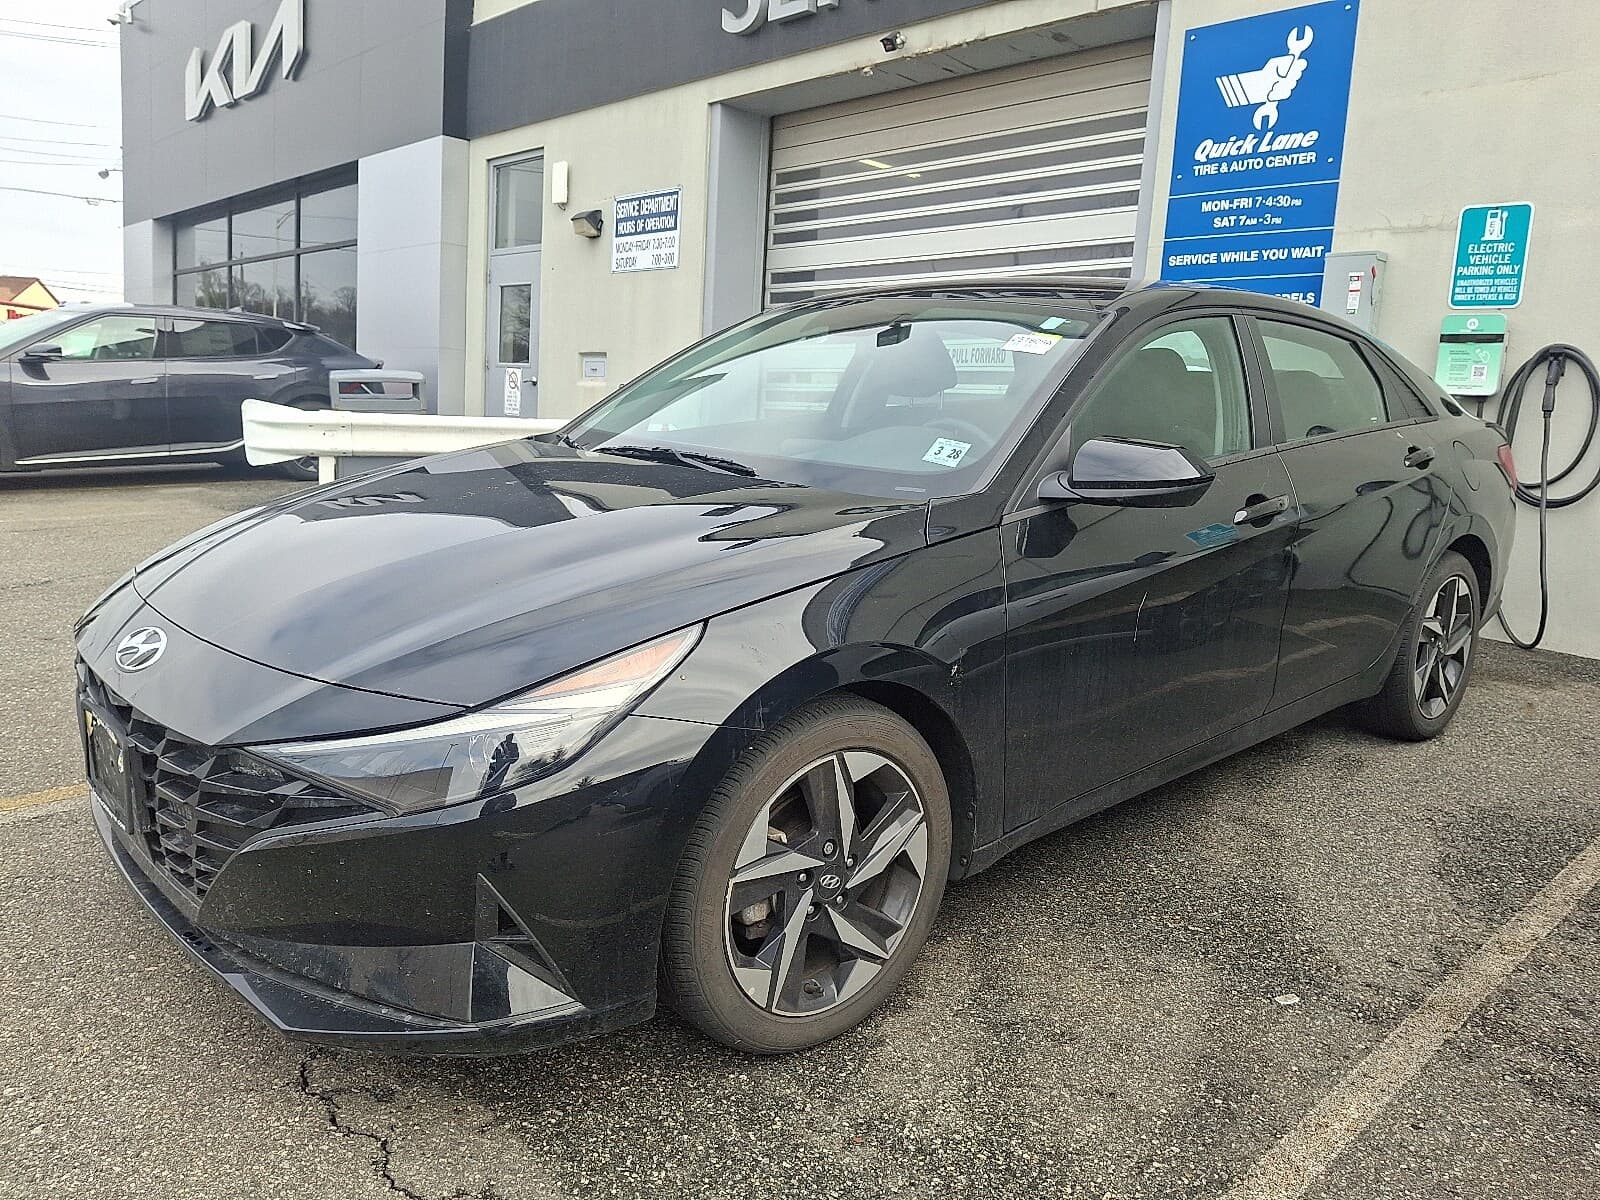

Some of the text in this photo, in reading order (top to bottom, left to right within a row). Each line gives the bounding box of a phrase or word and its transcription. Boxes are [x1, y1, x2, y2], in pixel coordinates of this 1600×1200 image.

[184, 0, 304, 121] KIA
[1194, 131, 1320, 162] Quick Lane
[1193, 152, 1317, 176] TIRE & AUTO CENTER
[616, 195, 678, 219] SERVICE DEPARTMENT
[1201, 197, 1253, 213] MON-FRI
[617, 215, 675, 235] HOURS OF OPERATION
[1213, 215, 1237, 228] SAT
[1168, 246, 1324, 266] SERVICE WHILE YOU WAIT
[1468, 242, 1515, 254] ELECTRIC
[1469, 254, 1511, 264] VEHICLE
[1456, 264, 1520, 276] PARKING ONLY
[970, 347, 1006, 364] FORWARD
[934, 446, 962, 460] 3 28
